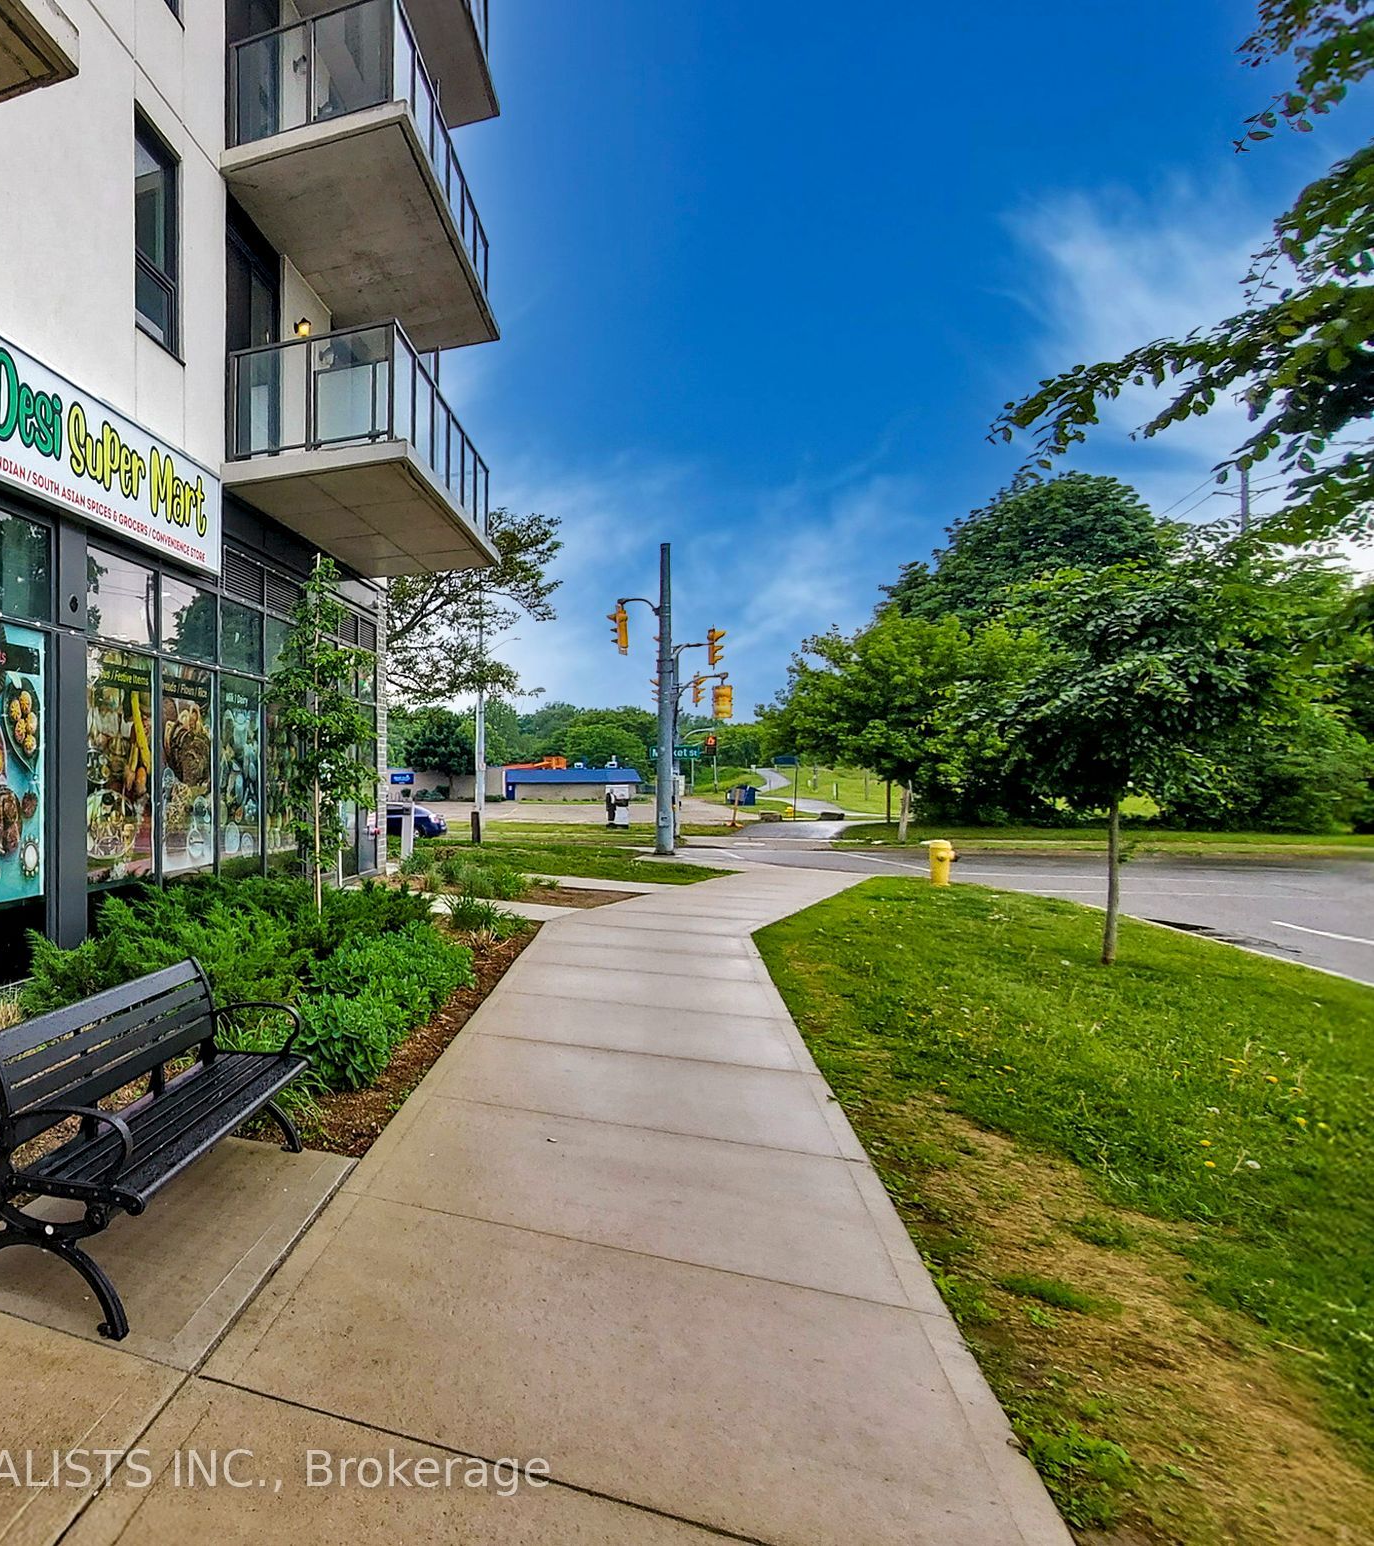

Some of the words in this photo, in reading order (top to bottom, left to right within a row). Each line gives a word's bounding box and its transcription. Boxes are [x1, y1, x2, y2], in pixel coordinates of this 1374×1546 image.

[67, 400, 146, 501] Super
[149, 445, 207, 538] Mart
[32, 472, 60, 496] SOUTH
[61, 486, 86, 507] ASIAN
[87, 498, 112, 518] SPICES
[113, 511, 118, 522] &
[118, 515, 149, 537] GROCERS
[152, 531, 190, 556] CONVENIENCE
[190, 547, 206, 563] STORE
[652, 748, 688, 757] Mket
